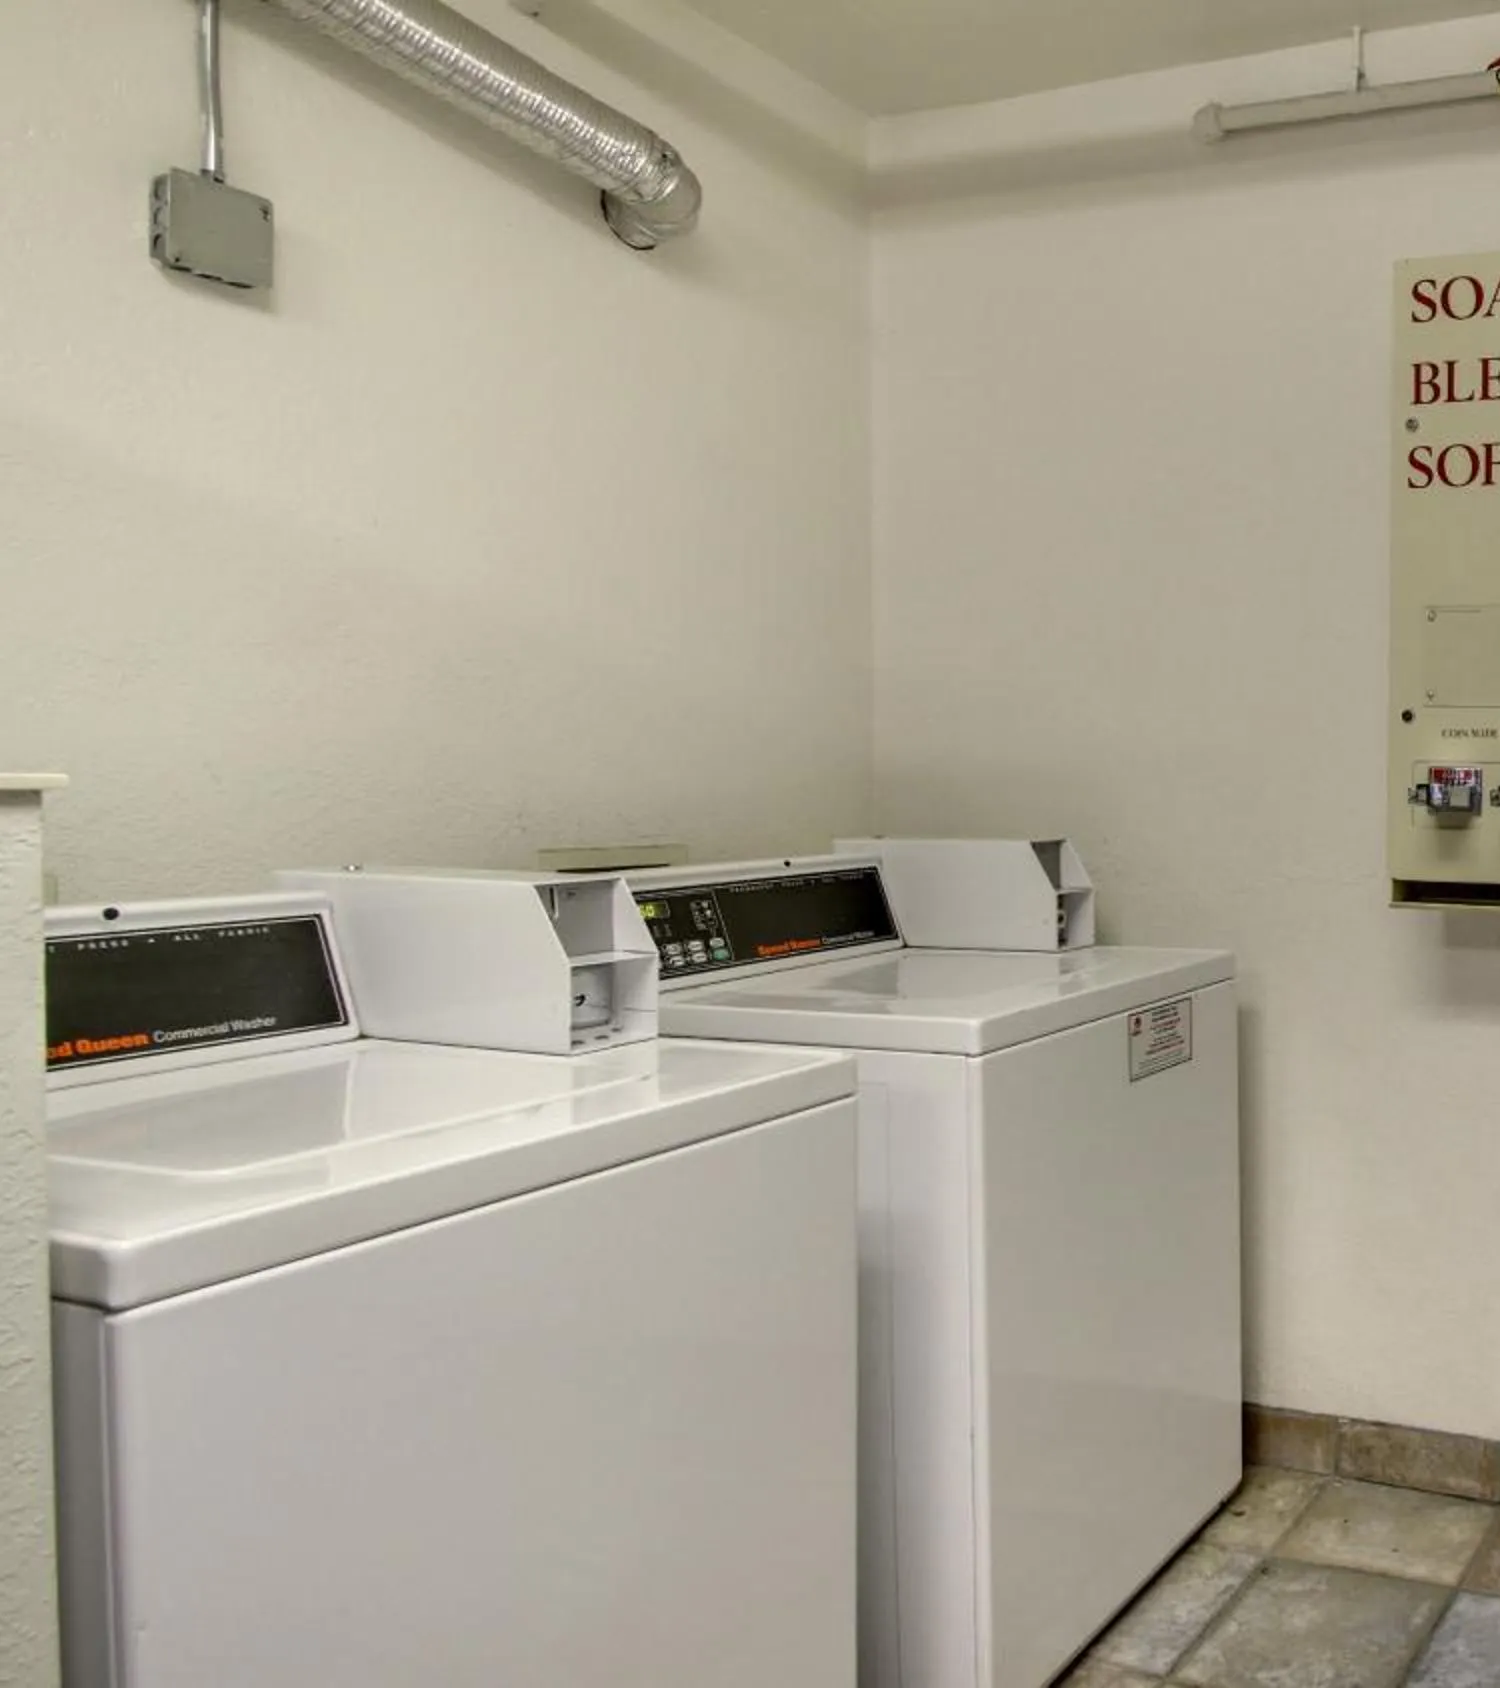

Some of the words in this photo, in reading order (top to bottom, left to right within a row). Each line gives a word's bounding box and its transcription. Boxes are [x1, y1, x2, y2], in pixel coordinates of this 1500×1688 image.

[75, 1031, 149, 1054] Queen
[152, 1022, 229, 1044] Commercial
[230, 1016, 277, 1033] Washer
